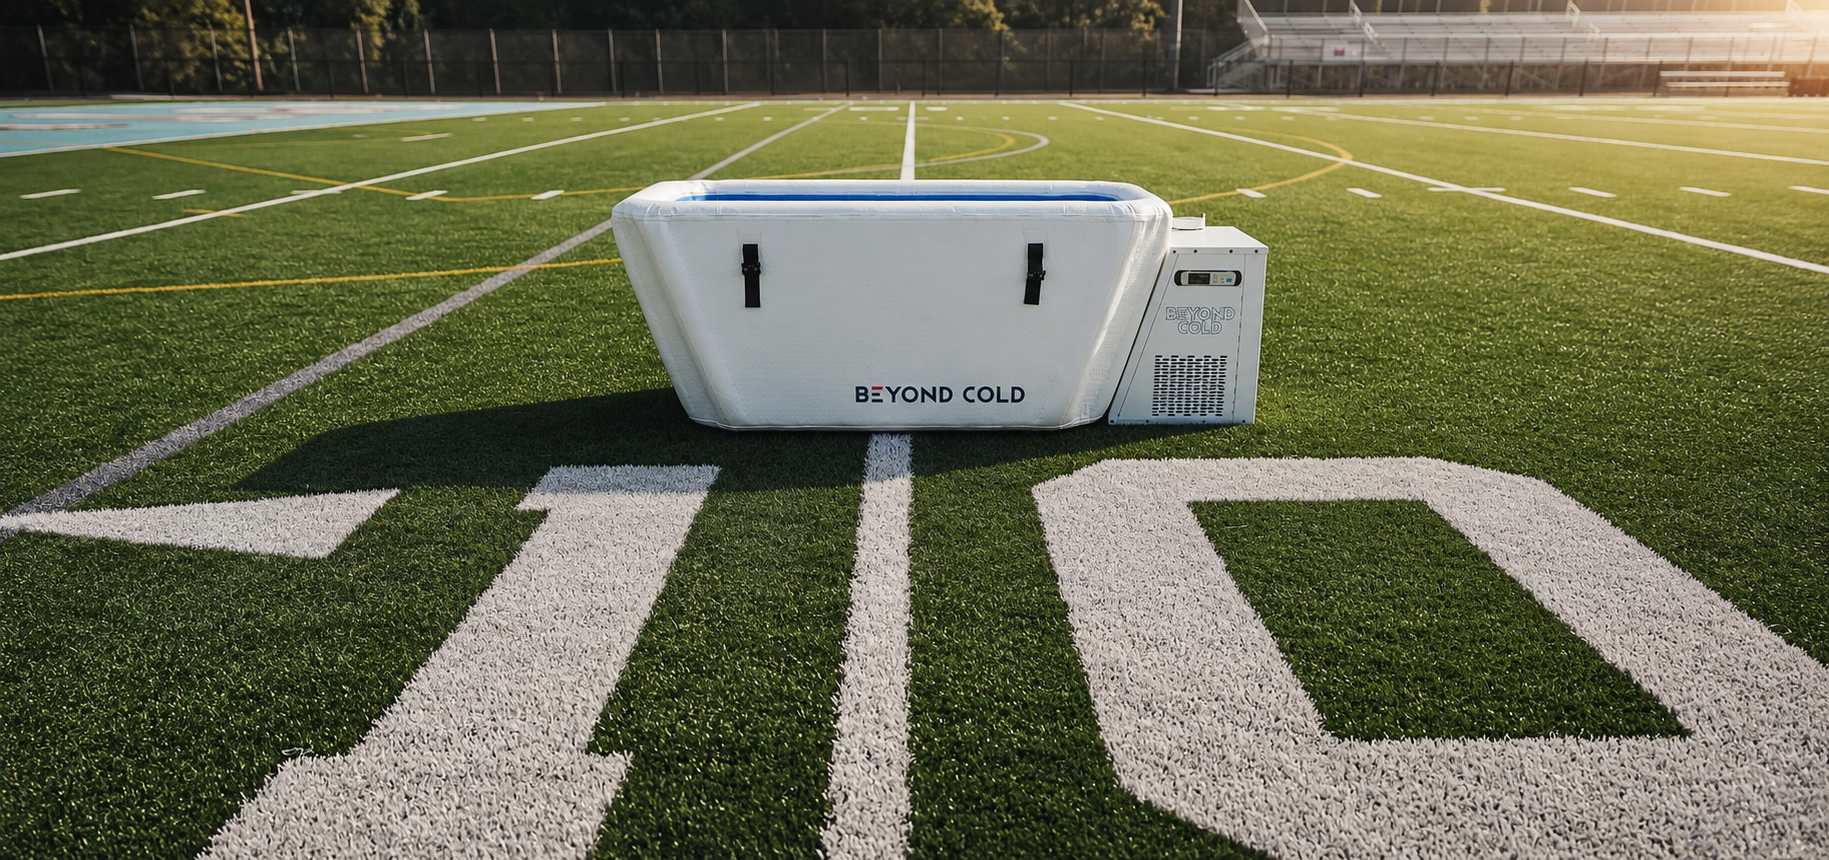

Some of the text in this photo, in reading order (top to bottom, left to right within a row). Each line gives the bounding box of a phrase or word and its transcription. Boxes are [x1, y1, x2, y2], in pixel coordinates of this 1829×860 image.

[1165, 306, 1236, 320] BEYOND
[1177, 320, 1223, 335] COLD
[855, 386, 1026, 403] BEYOND COLD
